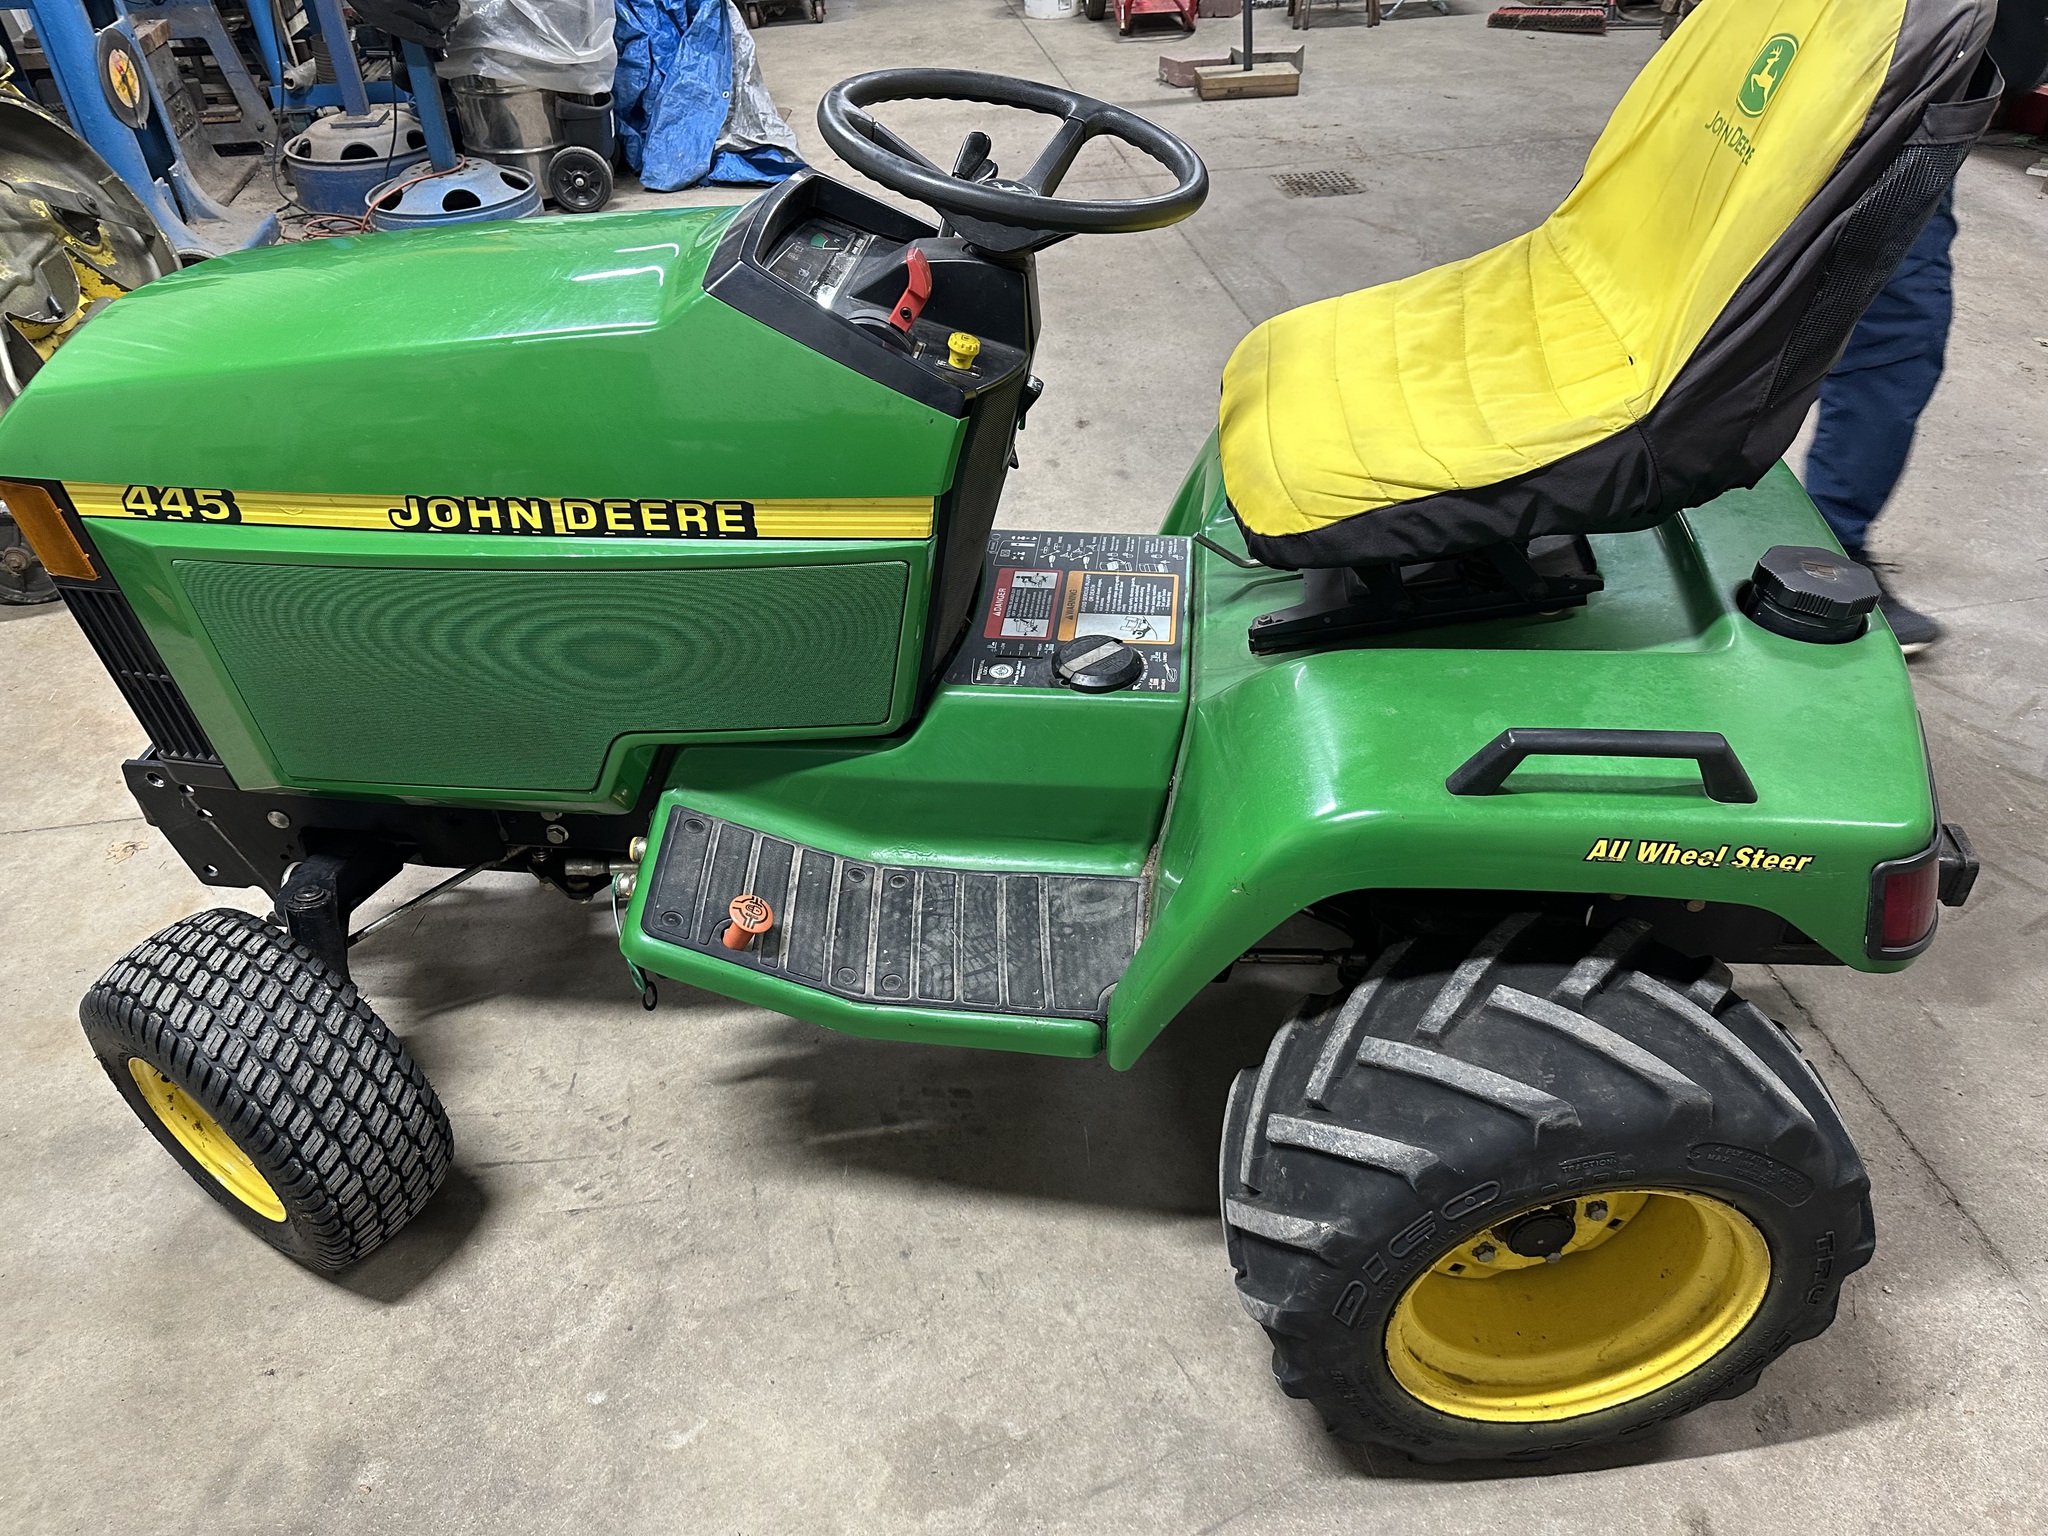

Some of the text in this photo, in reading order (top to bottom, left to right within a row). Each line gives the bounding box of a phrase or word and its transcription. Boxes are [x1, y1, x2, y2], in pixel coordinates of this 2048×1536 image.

[122, 487, 233, 519] 445
[389, 496, 750, 535] JOHN DEERE
[993, 588, 1006, 611] DANGER
[1065, 589, 1077, 615] WARNING
[1586, 839, 1813, 872] All Wheel Steer
